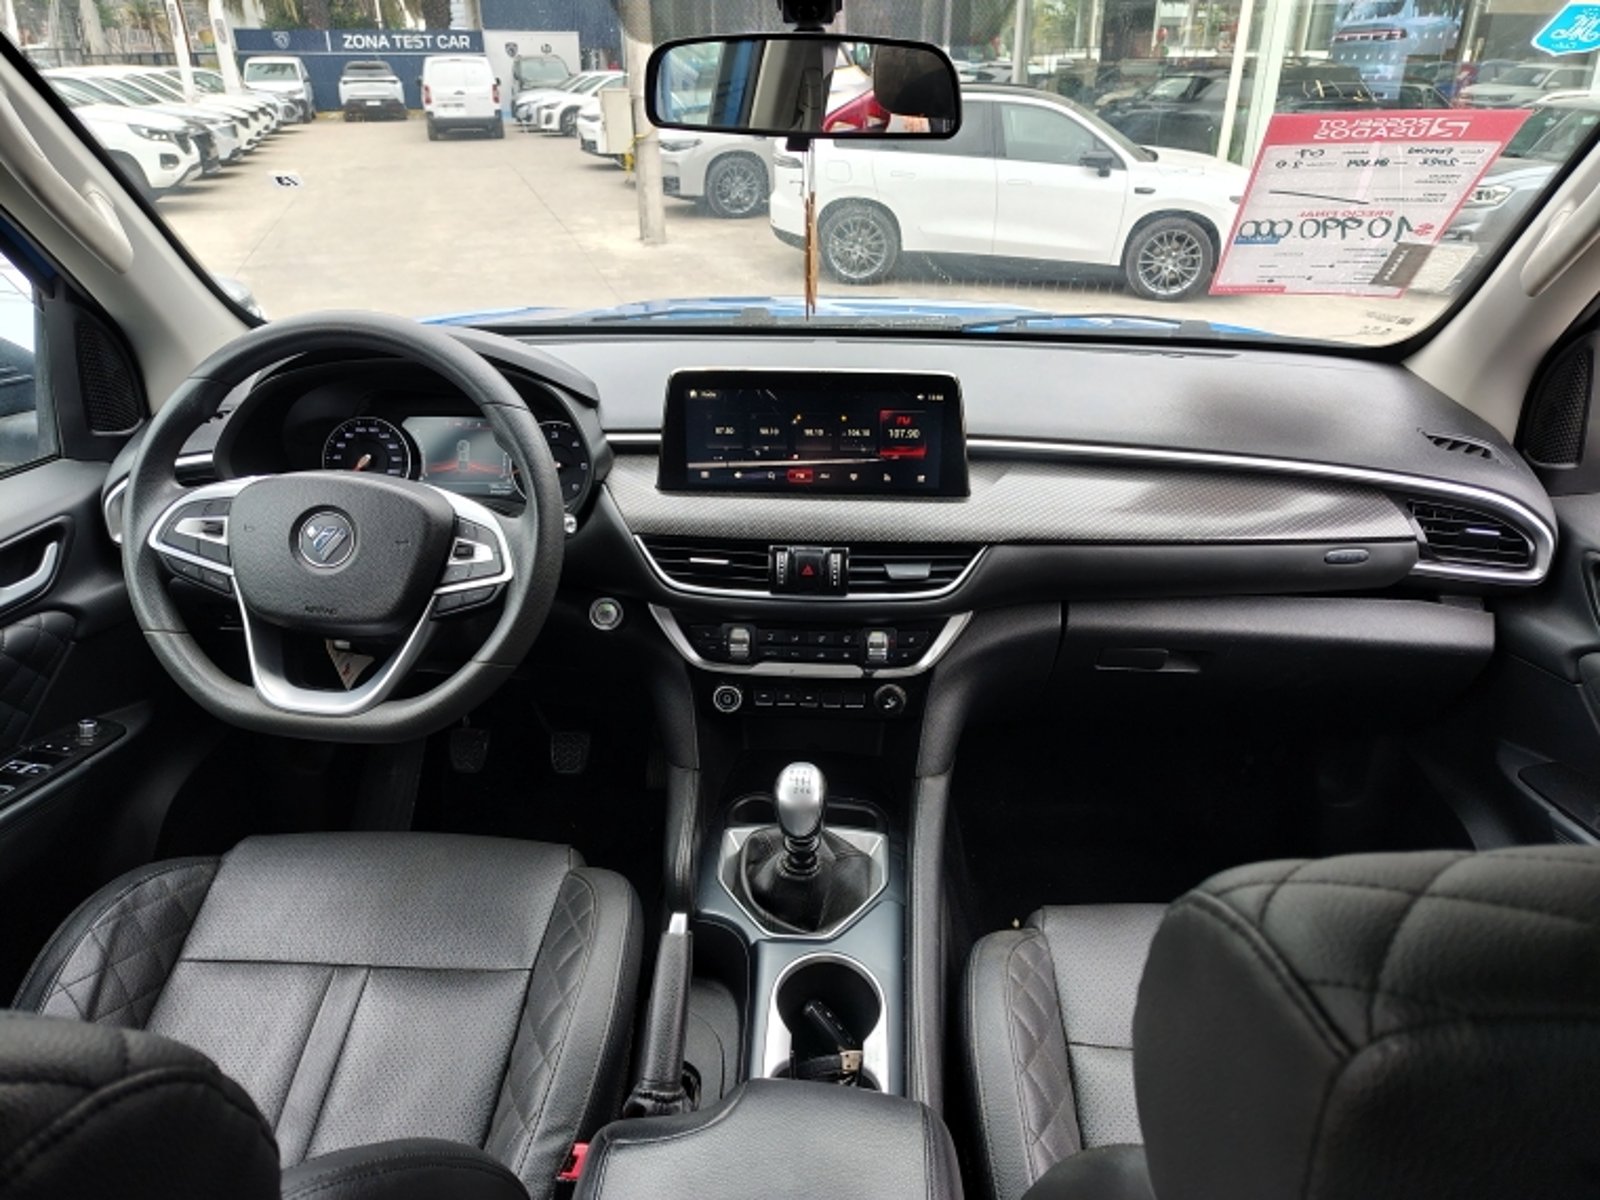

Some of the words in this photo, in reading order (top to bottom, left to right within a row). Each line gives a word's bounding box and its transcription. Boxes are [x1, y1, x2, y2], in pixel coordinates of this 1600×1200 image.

[342, 34, 390, 49] ZONA
[392, 34, 434, 49] TEST
[436, 34, 471, 49] CAR
